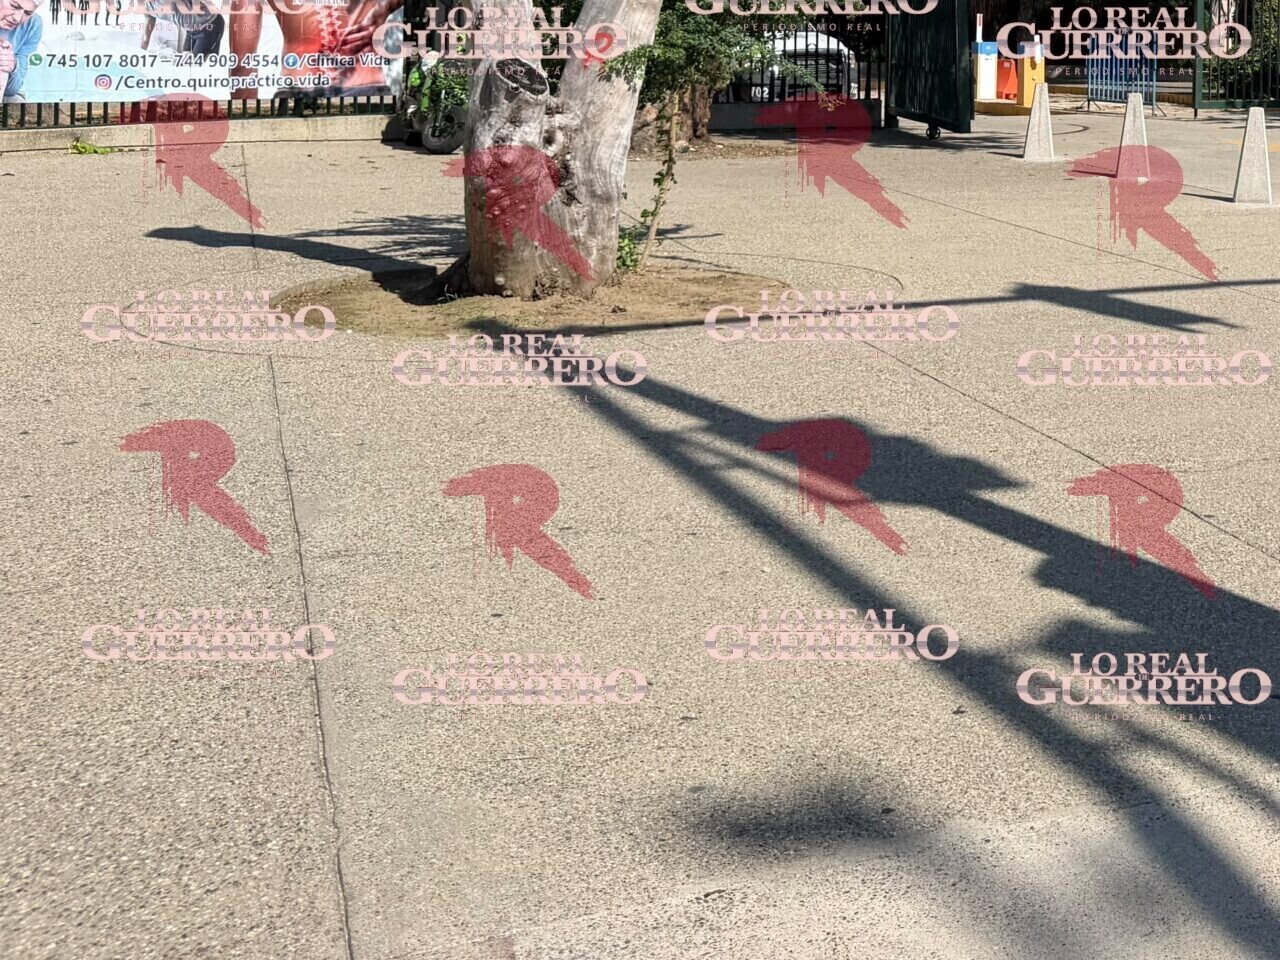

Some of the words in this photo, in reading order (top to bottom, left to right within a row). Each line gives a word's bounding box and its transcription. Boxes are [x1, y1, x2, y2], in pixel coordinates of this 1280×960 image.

[46, 54, 77, 68] 745
[84, 54, 112, 68] 107
[119, 54, 157, 68] 8017
[174, 54, 203, 68] 744
[209, 54, 237, 68] 909
[243, 54, 279, 68] 4554
[360, 54, 390, 68] Vida
